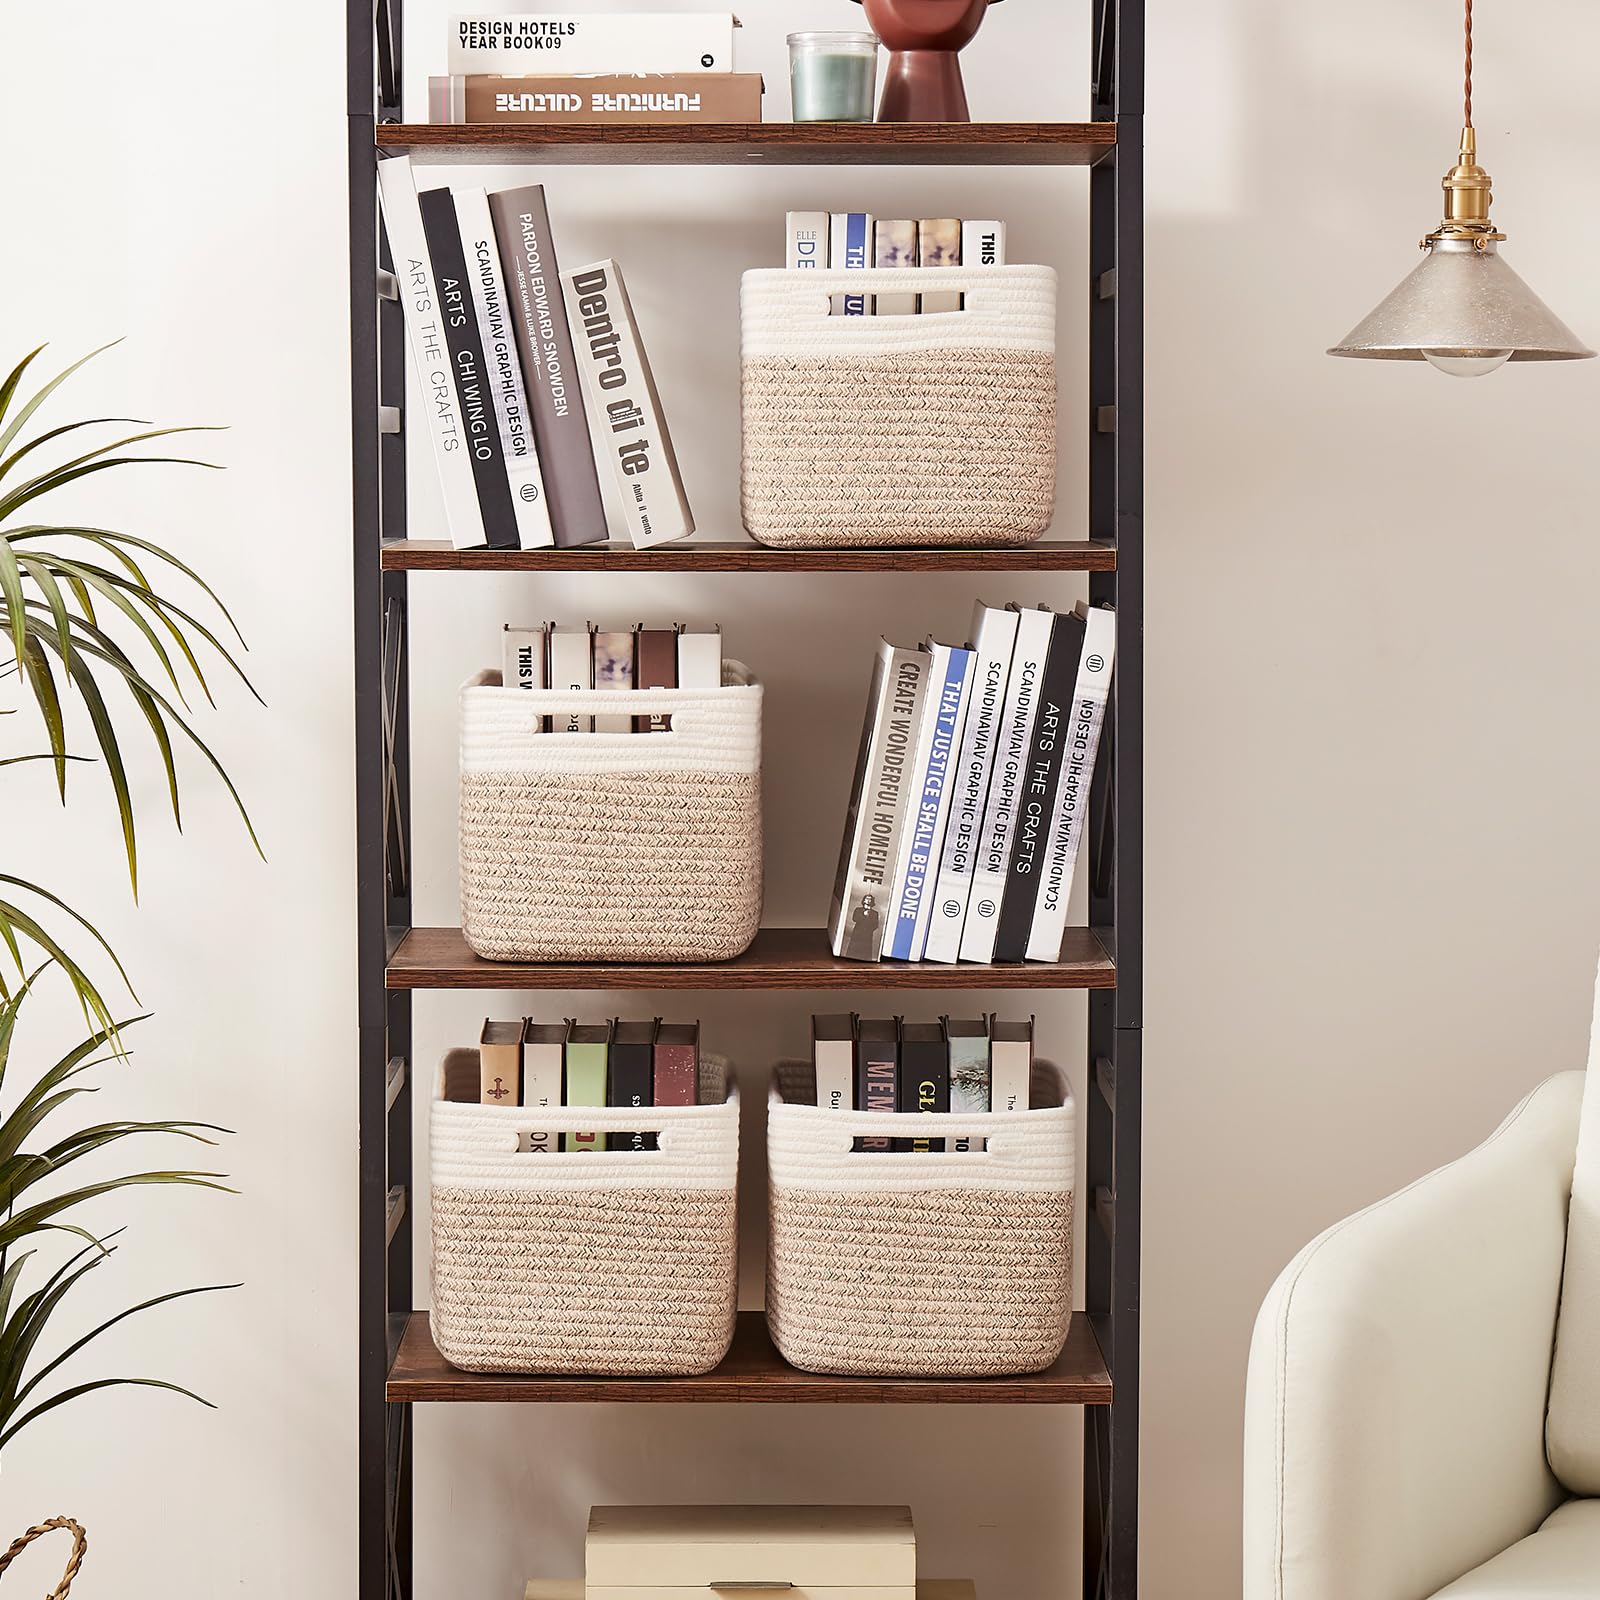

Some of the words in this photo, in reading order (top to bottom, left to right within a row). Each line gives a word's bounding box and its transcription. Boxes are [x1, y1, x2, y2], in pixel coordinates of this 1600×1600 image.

[459, 21, 512, 35] DESIGN
[459, 36, 497, 49] YEAR
[495, 93, 582, 112] CULTURE
[591, 93, 701, 112] FURNITURE
[796, 231, 817, 240] ELLE
[981, 233, 995, 265] THIS
[407, 259, 431, 312] ARTS
[442, 278, 467, 328] ARTS
[519, 213, 543, 274] PARDON
[531, 276, 554, 340] EDWARD
[543, 341, 569, 417] SNOWDEN
[571, 268, 628, 391] Dentro
[421, 320, 442, 361] THE
[474, 240, 506, 339] SCANDINAVIAV
[494, 342, 517, 404] GRAPHIC
[506, 406, 528, 457] DESIGN
[457, 350, 477, 381] CHI
[430, 371, 459, 452] CRAFTS
[464, 384, 487, 434] WING
[606, 398, 645, 434] di
[473, 437, 492, 461] LO
[618, 439, 650, 476] te
[518, 646, 533, 678] THIS
[893, 662, 921, 715] CREATE
[939, 681, 962, 726] THAT
[972, 661, 1001, 760] SCANDINAVIAV
[1008, 661, 1037, 760] SCANDINAVIAV
[1039, 702, 1061, 751] ARTS
[876, 720, 911, 807] WONDERFUL
[924, 728, 952, 798] JUSTICE
[1030, 760, 1051, 795] THE
[961, 761, 983, 821] GRAPHIC
[996, 761, 1018, 821] GRAPHIC
[1044, 813, 1073, 911] SCANDINAVIAV
[1062, 752, 1085, 812] GRAPHIC
[1074, 699, 1095, 750] DESIGN
[862, 812, 894, 885] HOMELIFE
[914, 801, 938, 850] SHALL
[952, 823, 973, 873] DESIGN
[987, 823, 1008, 873] DESIGN
[1016, 802, 1042, 874] CRAFTS
[909, 853, 928, 874] BE
[900, 875, 922, 920] DONE
[1007, 1095, 1017, 1111] The
